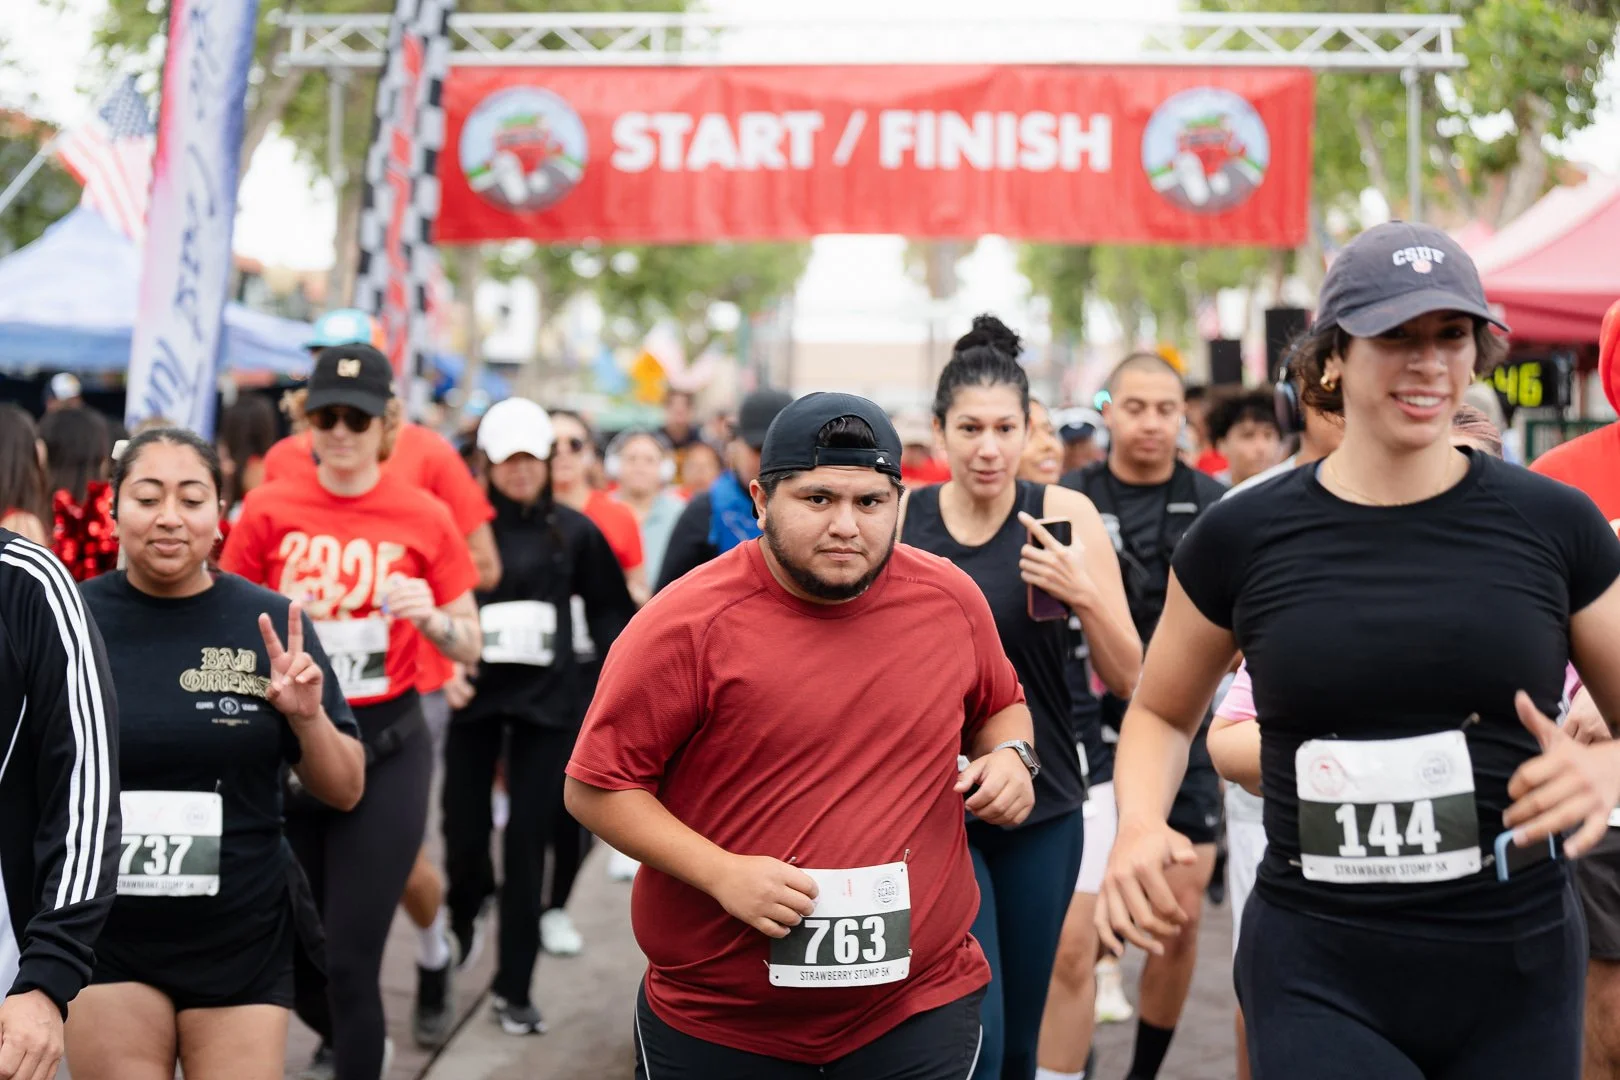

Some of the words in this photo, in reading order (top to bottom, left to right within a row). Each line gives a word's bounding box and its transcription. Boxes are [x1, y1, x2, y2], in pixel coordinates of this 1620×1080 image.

[611, 110, 824, 172] START
[833, 109, 868, 168] /
[879, 110, 1113, 172] FINISH
[201, 647, 257, 672] BAD
[1335, 799, 1441, 857] 144
[119, 835, 193, 875] 737
[1334, 862, 1397, 876] STRAWBERRY
[1400, 861, 1433, 875] STOMP
[1436, 861, 1448, 872] 5K
[804, 916, 886, 964] 763
[800, 970, 852, 980] STRAWBERRY
[854, 968, 879, 979] STOMP
[881, 967, 890, 977] 5K
